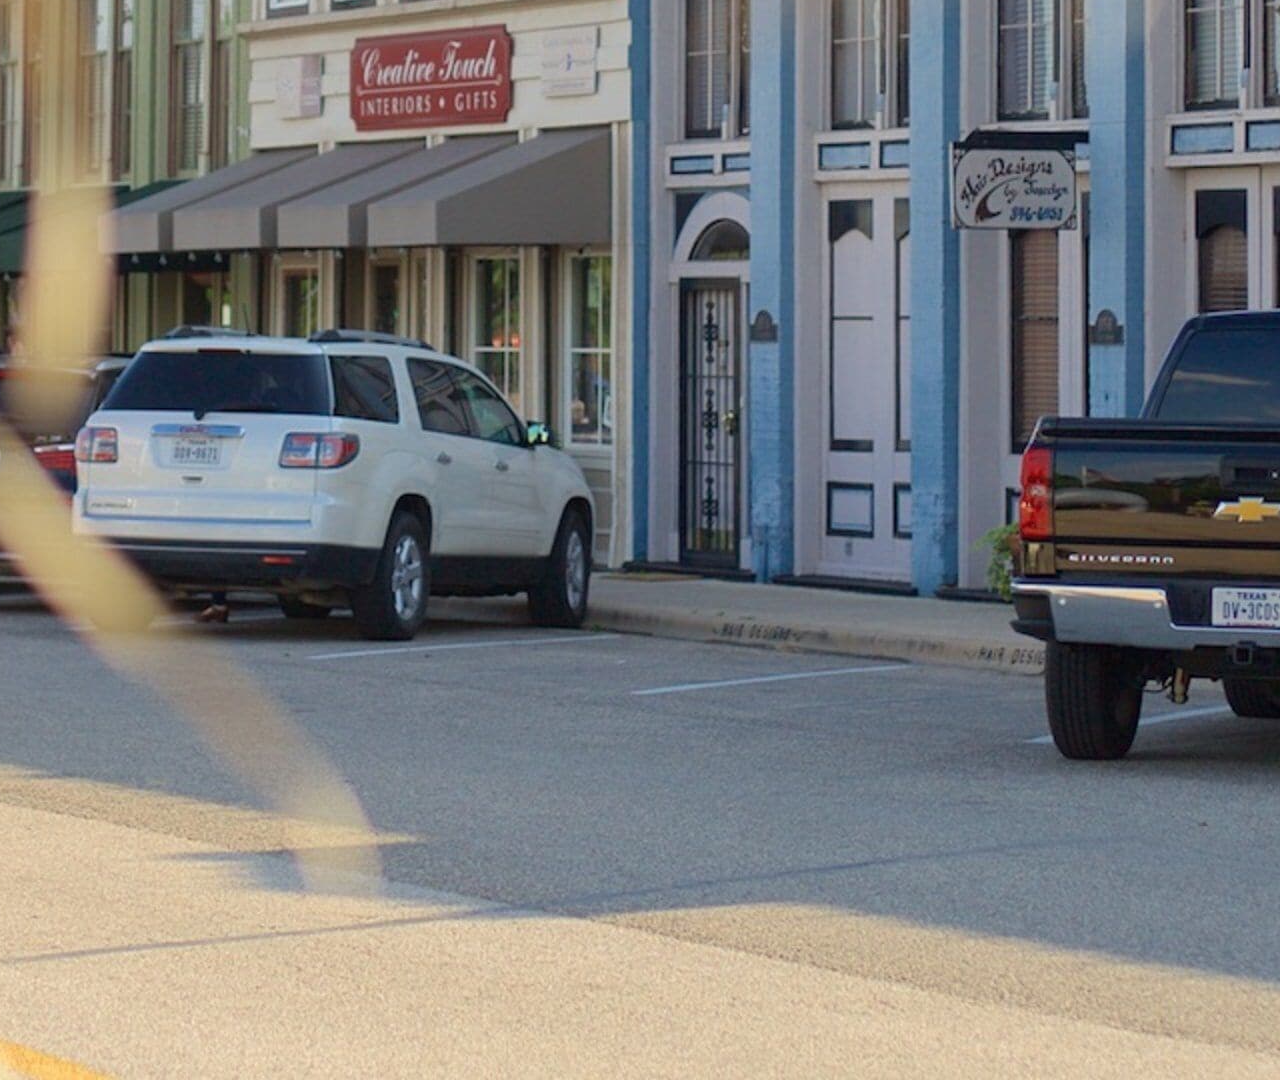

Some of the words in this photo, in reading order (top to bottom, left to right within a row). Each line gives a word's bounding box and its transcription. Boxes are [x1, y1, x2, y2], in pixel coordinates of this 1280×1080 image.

[361, 48, 435, 86] Creative
[439, 39, 497, 80] Touch
[360, 94, 431, 116] INTERIORS
[454, 90, 497, 112] GIFTS
[988, 157, 1053, 181] Designs
[1237, 592, 1267, 601] TEXAS
